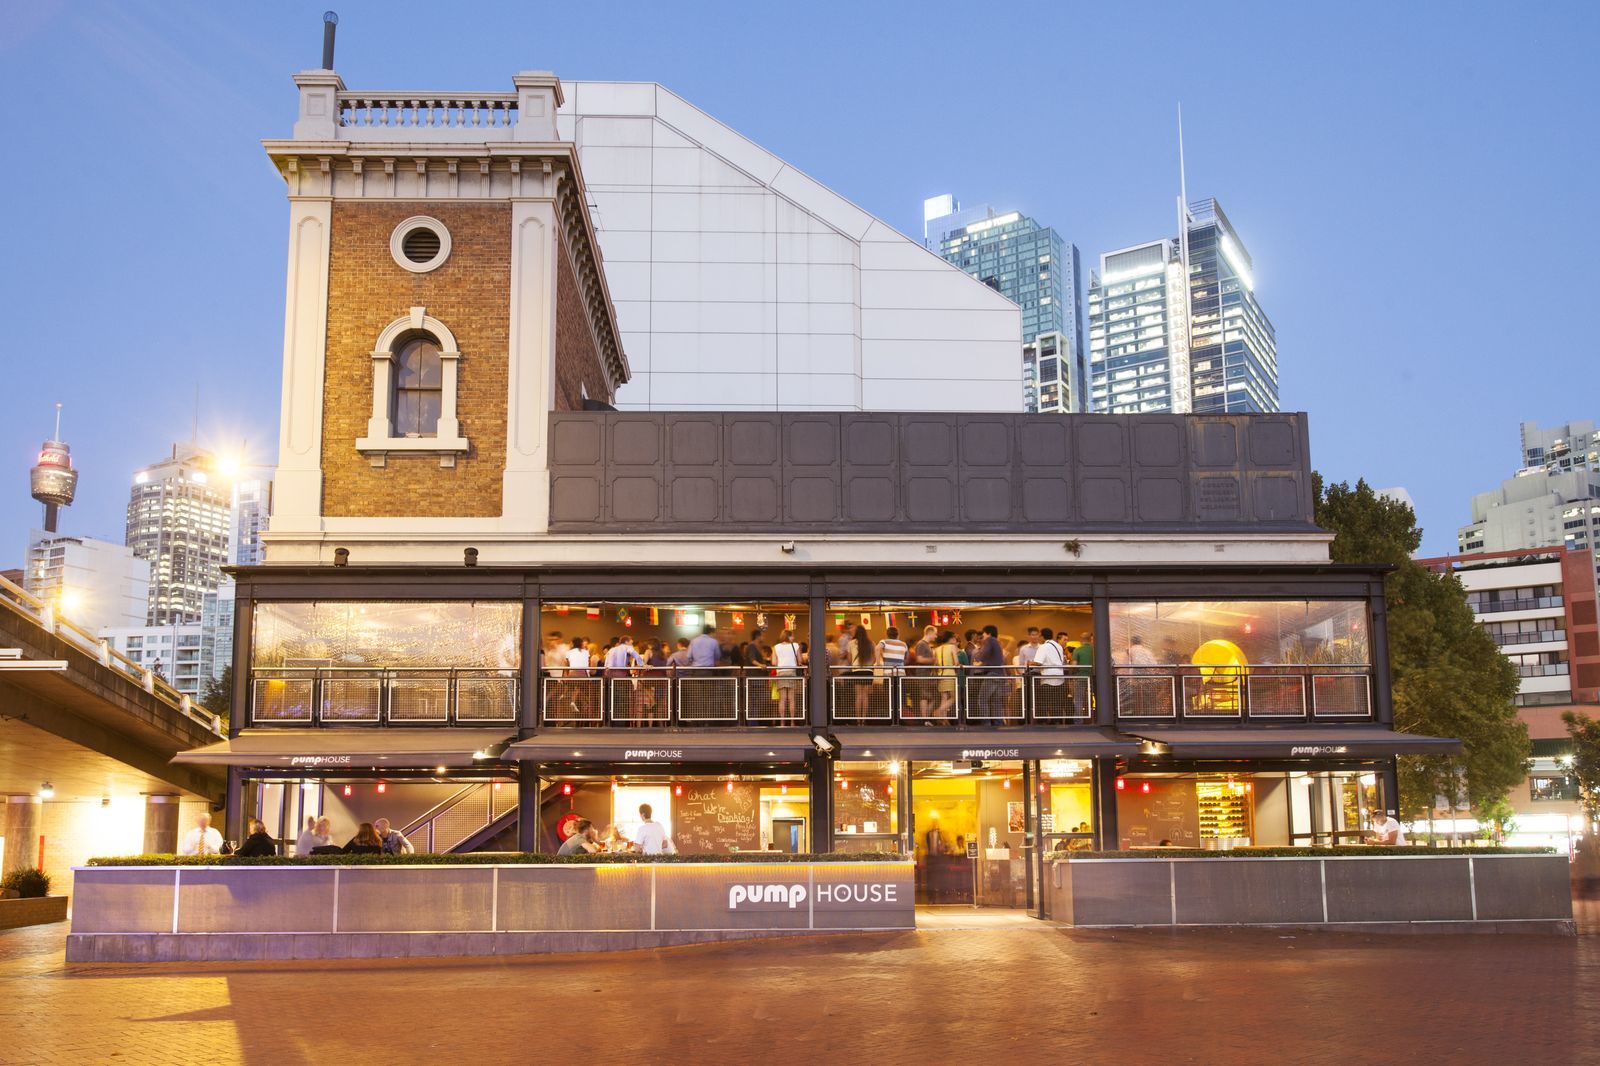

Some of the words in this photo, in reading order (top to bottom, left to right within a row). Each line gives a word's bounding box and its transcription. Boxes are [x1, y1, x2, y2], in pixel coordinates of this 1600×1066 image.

[1291, 746, 1348, 756] pumpHOU
[687, 789, 717, 801] What
[729, 884, 807, 909] pump
[817, 884, 898, 902] HOUSE
